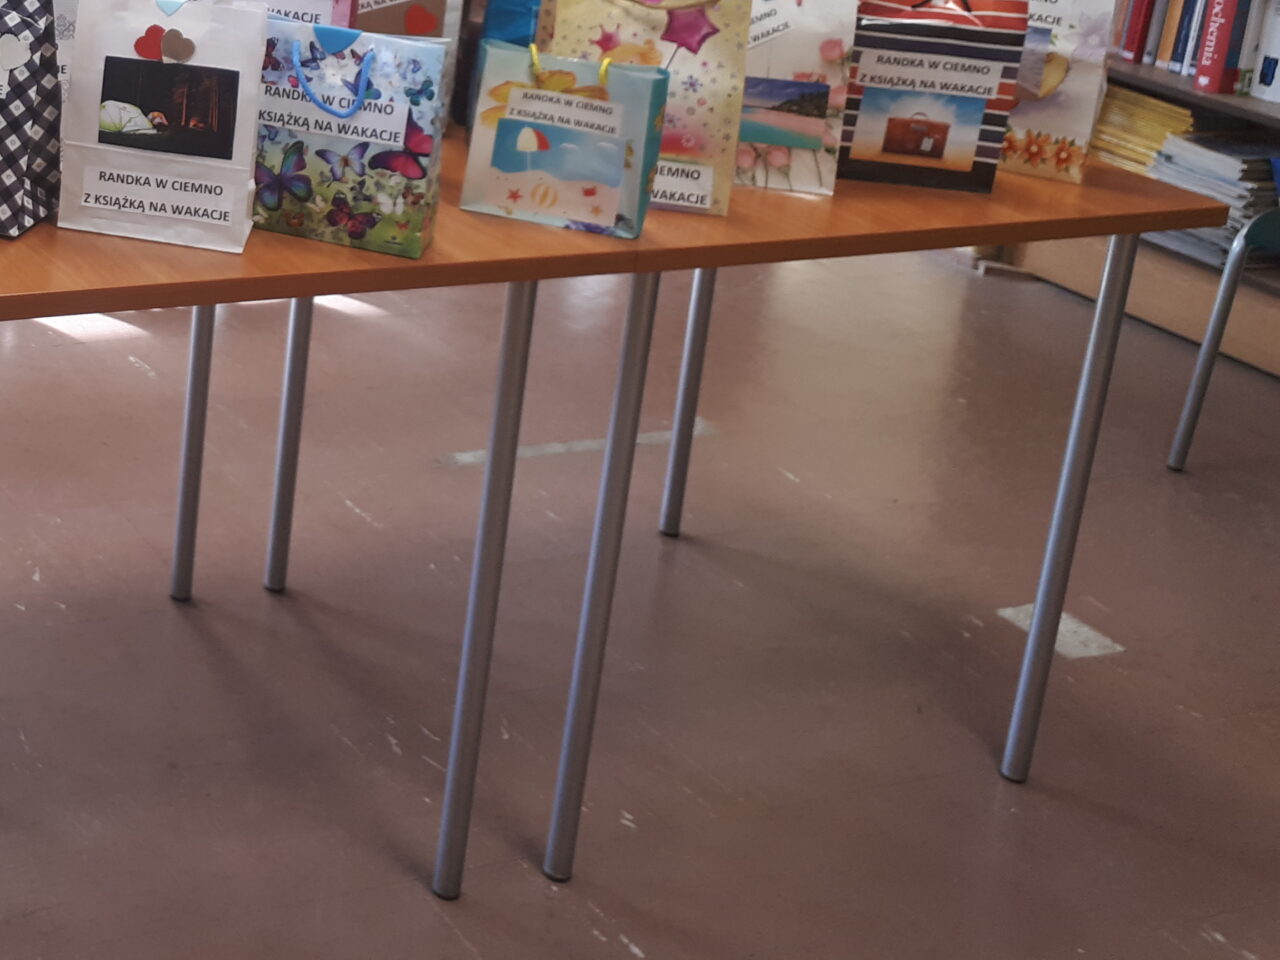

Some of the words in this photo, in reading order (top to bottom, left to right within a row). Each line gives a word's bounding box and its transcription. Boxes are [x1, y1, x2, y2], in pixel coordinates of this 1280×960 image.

[876, 55, 925, 68] RANDKA
[928, 60, 940, 70] W
[942, 62, 991, 75] CIEMNO
[859, 73, 867, 82] Z
[869, 74, 916, 89] KSIĄŻKĄ
[919, 80, 936, 89] NA
[940, 82, 993, 96] WAKACJE
[321, 94, 335, 106] W
[522, 92, 562, 105] RANDKA
[564, 99, 573, 107] W
[575, 101, 614, 115] CIEMNO
[258, 109, 310, 131] KSIĄŻKĄ
[313, 119, 333, 132] NA
[337, 122, 401, 143] WAKACJE
[509, 108, 515, 116] Z
[517, 110, 555, 124] KSIĄŻKĄ
[557, 115, 571, 125] NA
[573, 119, 617, 135] WAKACJE
[99, 171, 151, 187] RANDKA
[155, 178, 168, 189] W
[171, 180, 223, 196] CIEMNO
[656, 165, 701, 180] IEMNO
[84, 193, 91, 203] Z
[94, 194, 145, 213] KSIĄŻKĄ
[149, 201, 167, 213] NA
[171, 205, 231, 222] WAKACJE
